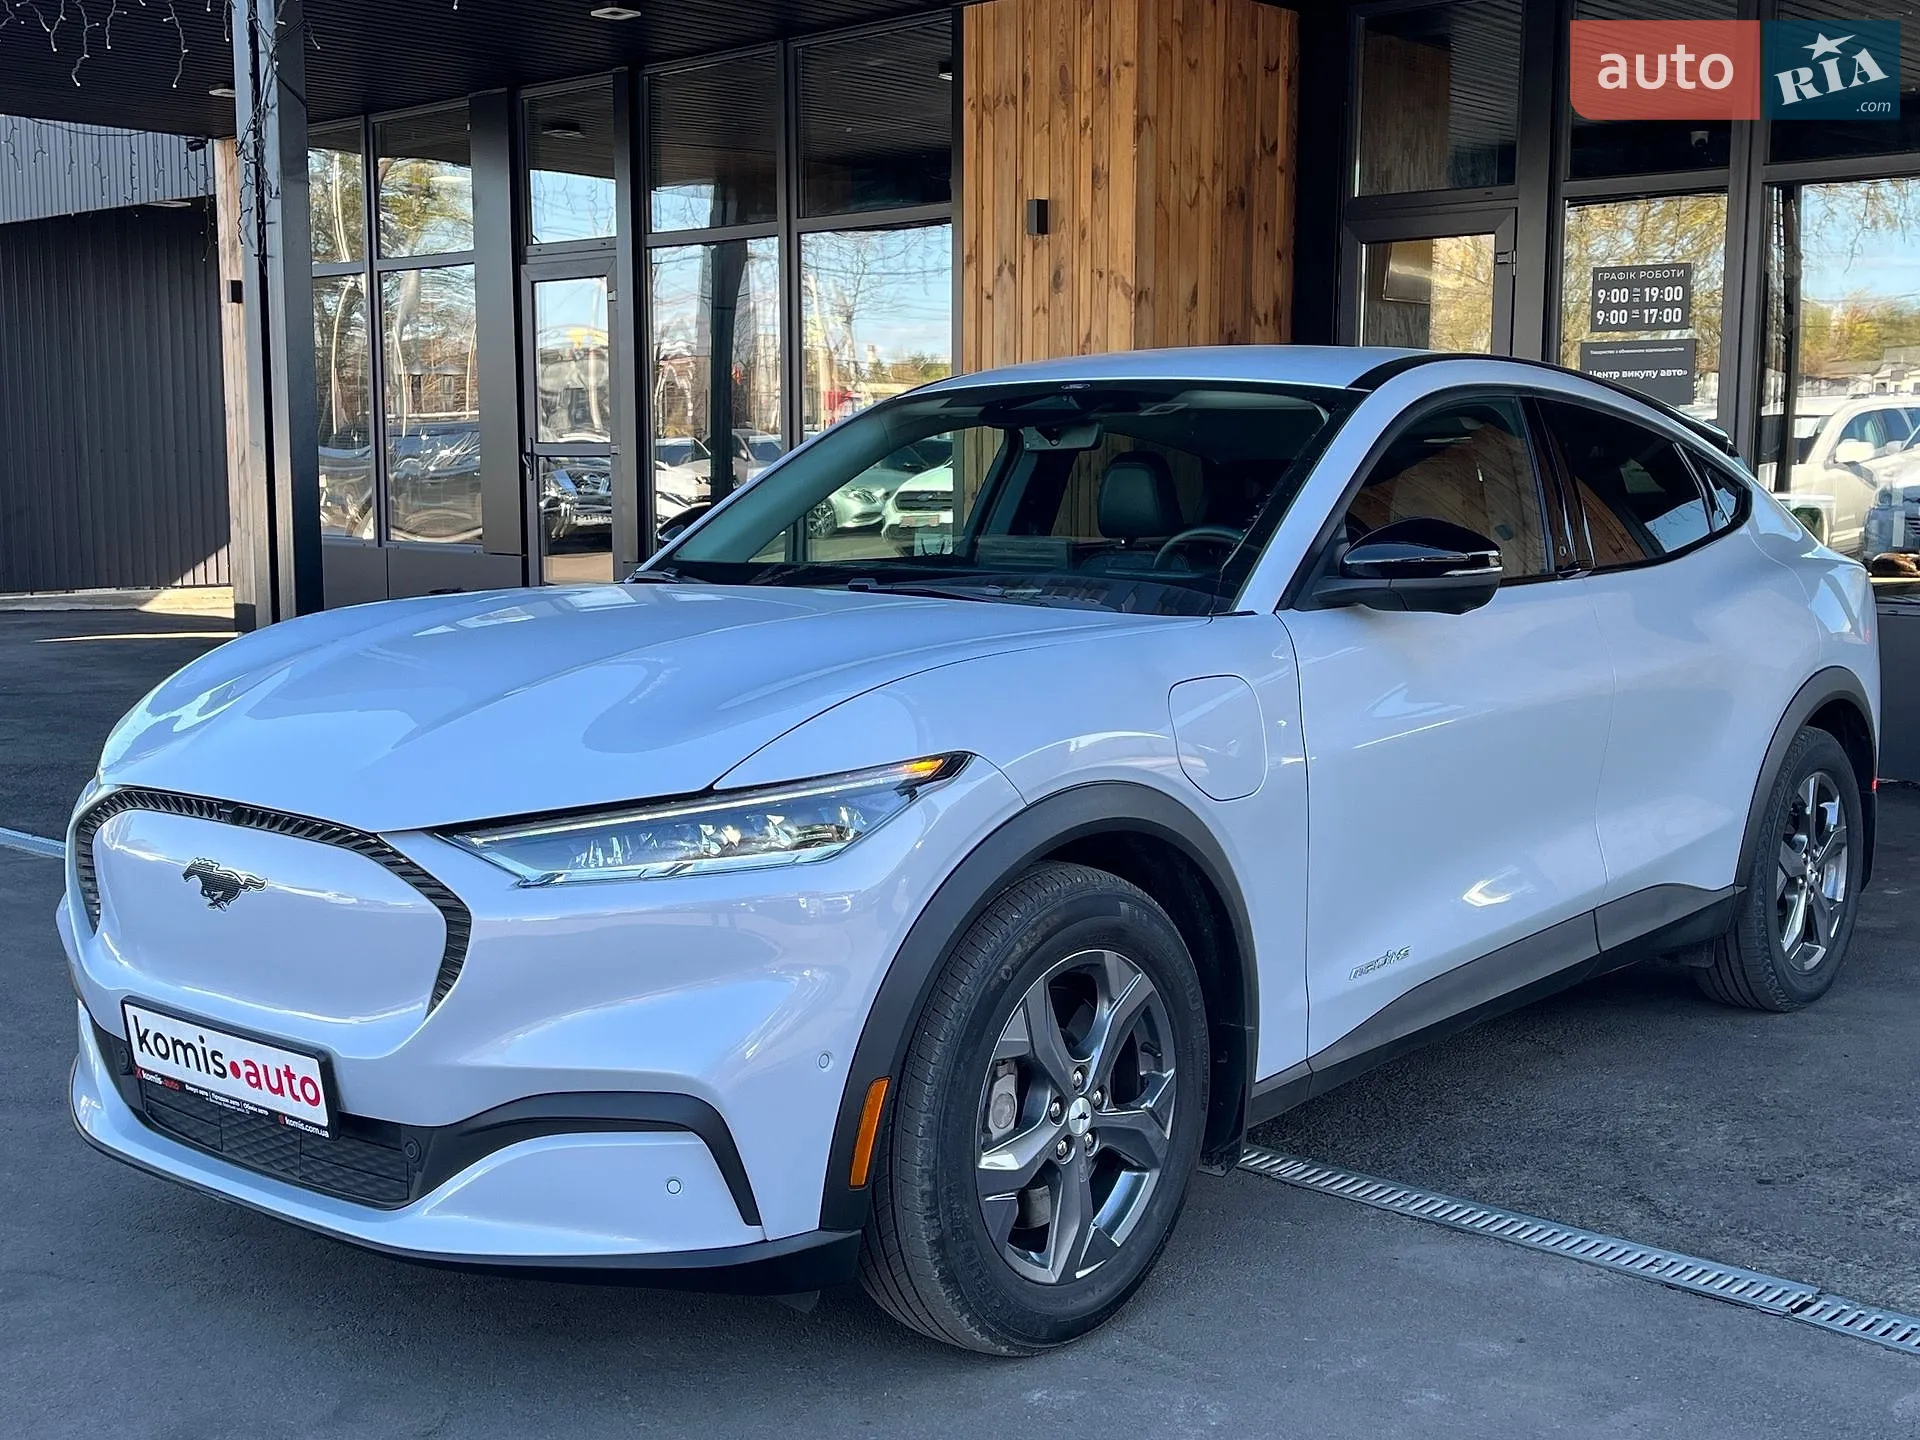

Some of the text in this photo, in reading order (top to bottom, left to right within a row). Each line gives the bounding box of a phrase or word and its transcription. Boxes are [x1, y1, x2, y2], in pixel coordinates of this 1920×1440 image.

[1598, 269, 1685, 281] ГРАФІК РОБОТИ
[1597, 288, 1629, 304] 9:00
[1644, 286, 1683, 302] 19:00
[1596, 307, 1682, 325] 9:00 17:00
[1621, 369, 1659, 380] викупу
